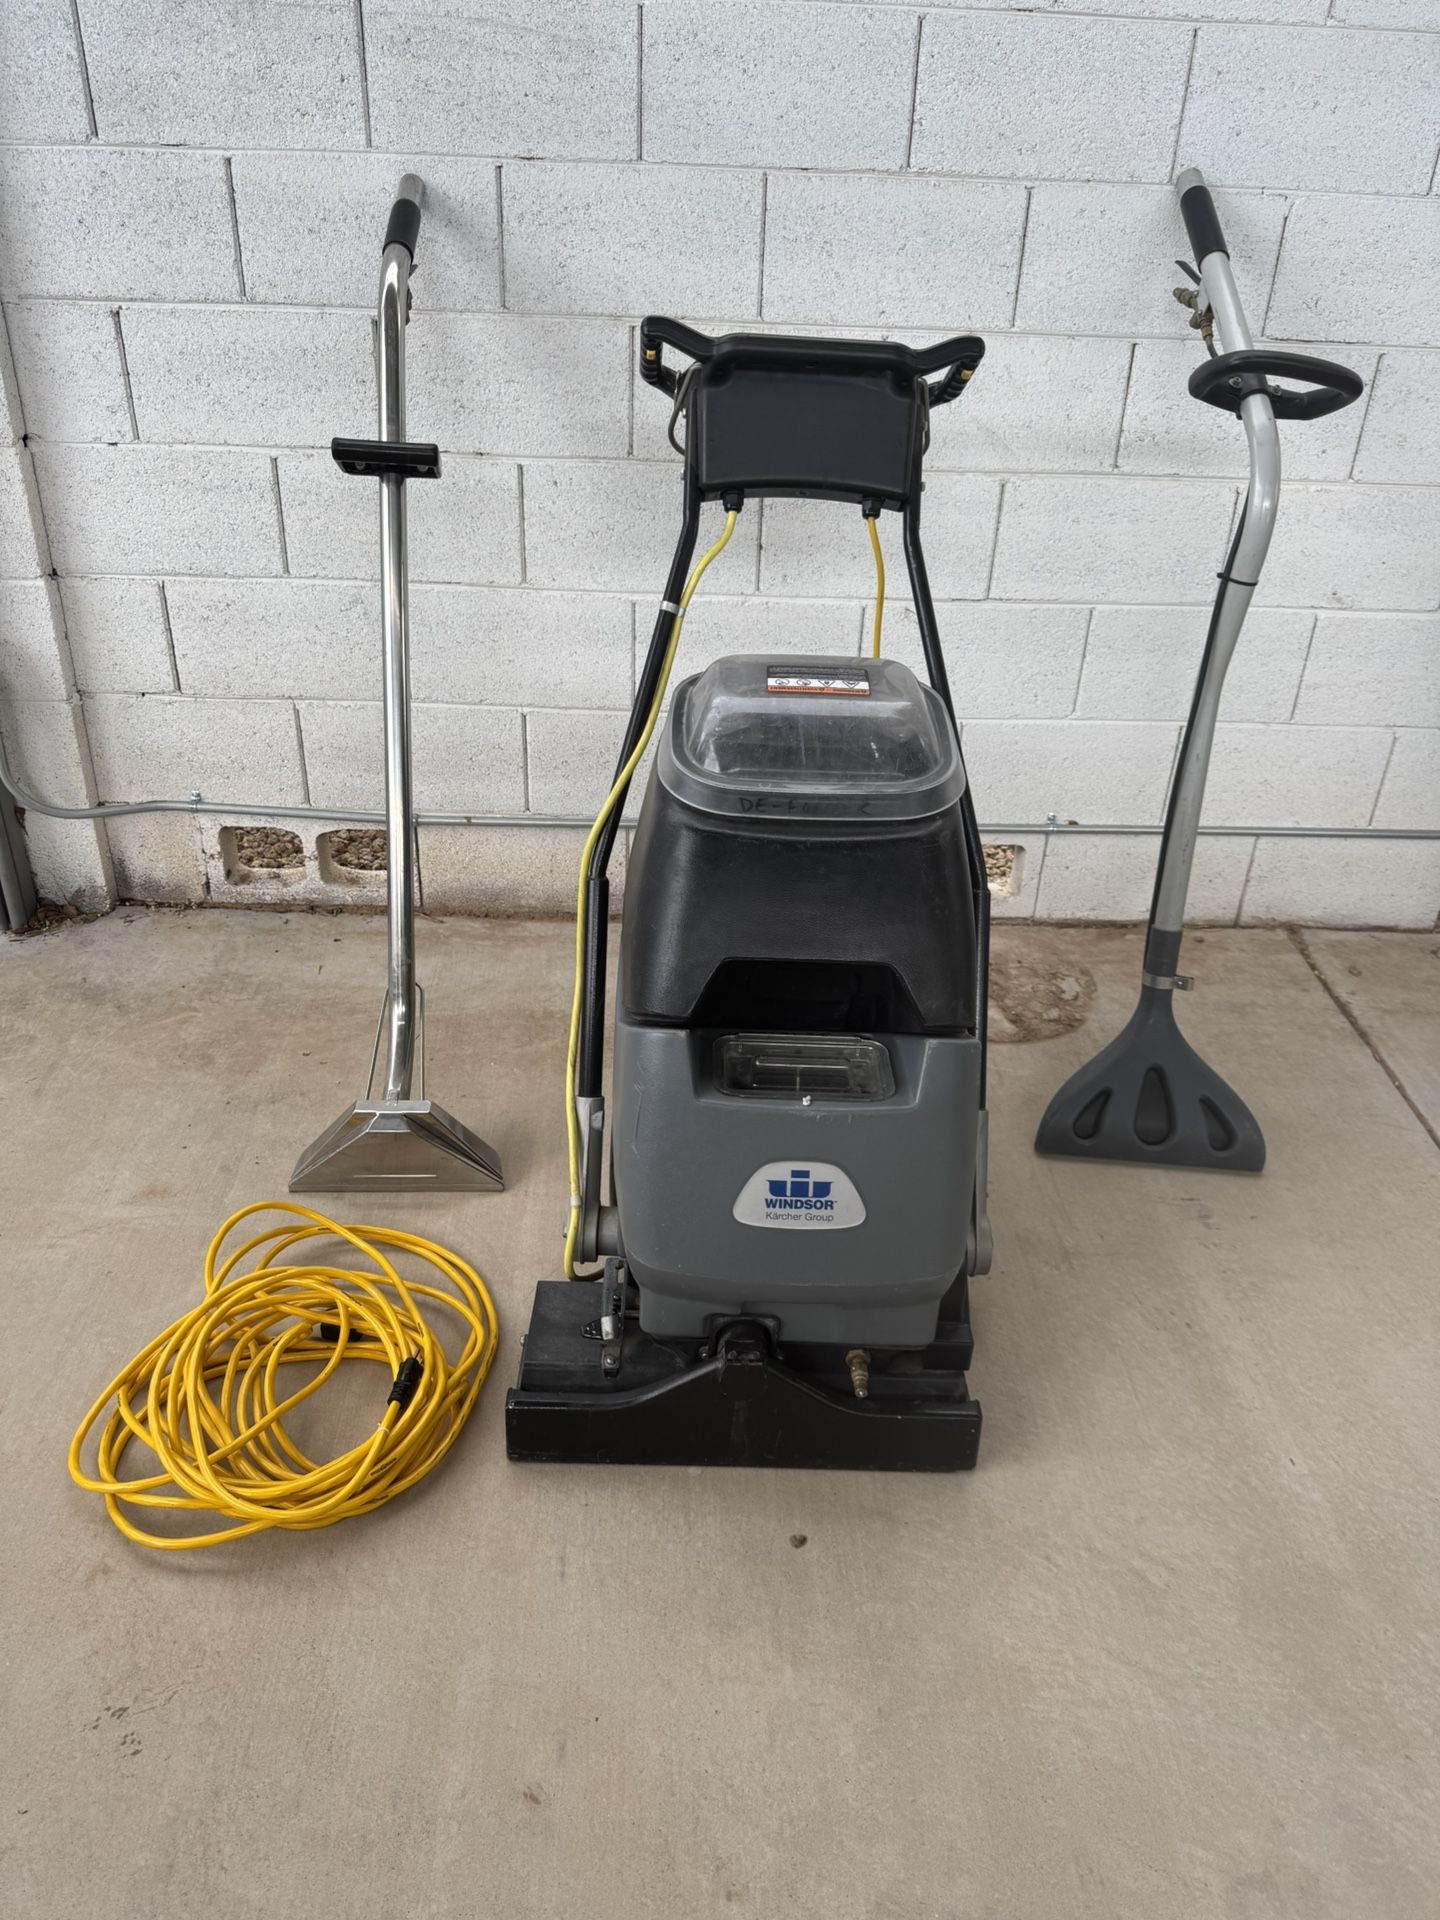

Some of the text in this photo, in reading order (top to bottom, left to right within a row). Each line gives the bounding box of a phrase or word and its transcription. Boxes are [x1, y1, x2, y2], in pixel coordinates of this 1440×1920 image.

[765, 1198, 834, 1210] WINDSOR
[766, 1211, 834, 1222] Kärcher Group
